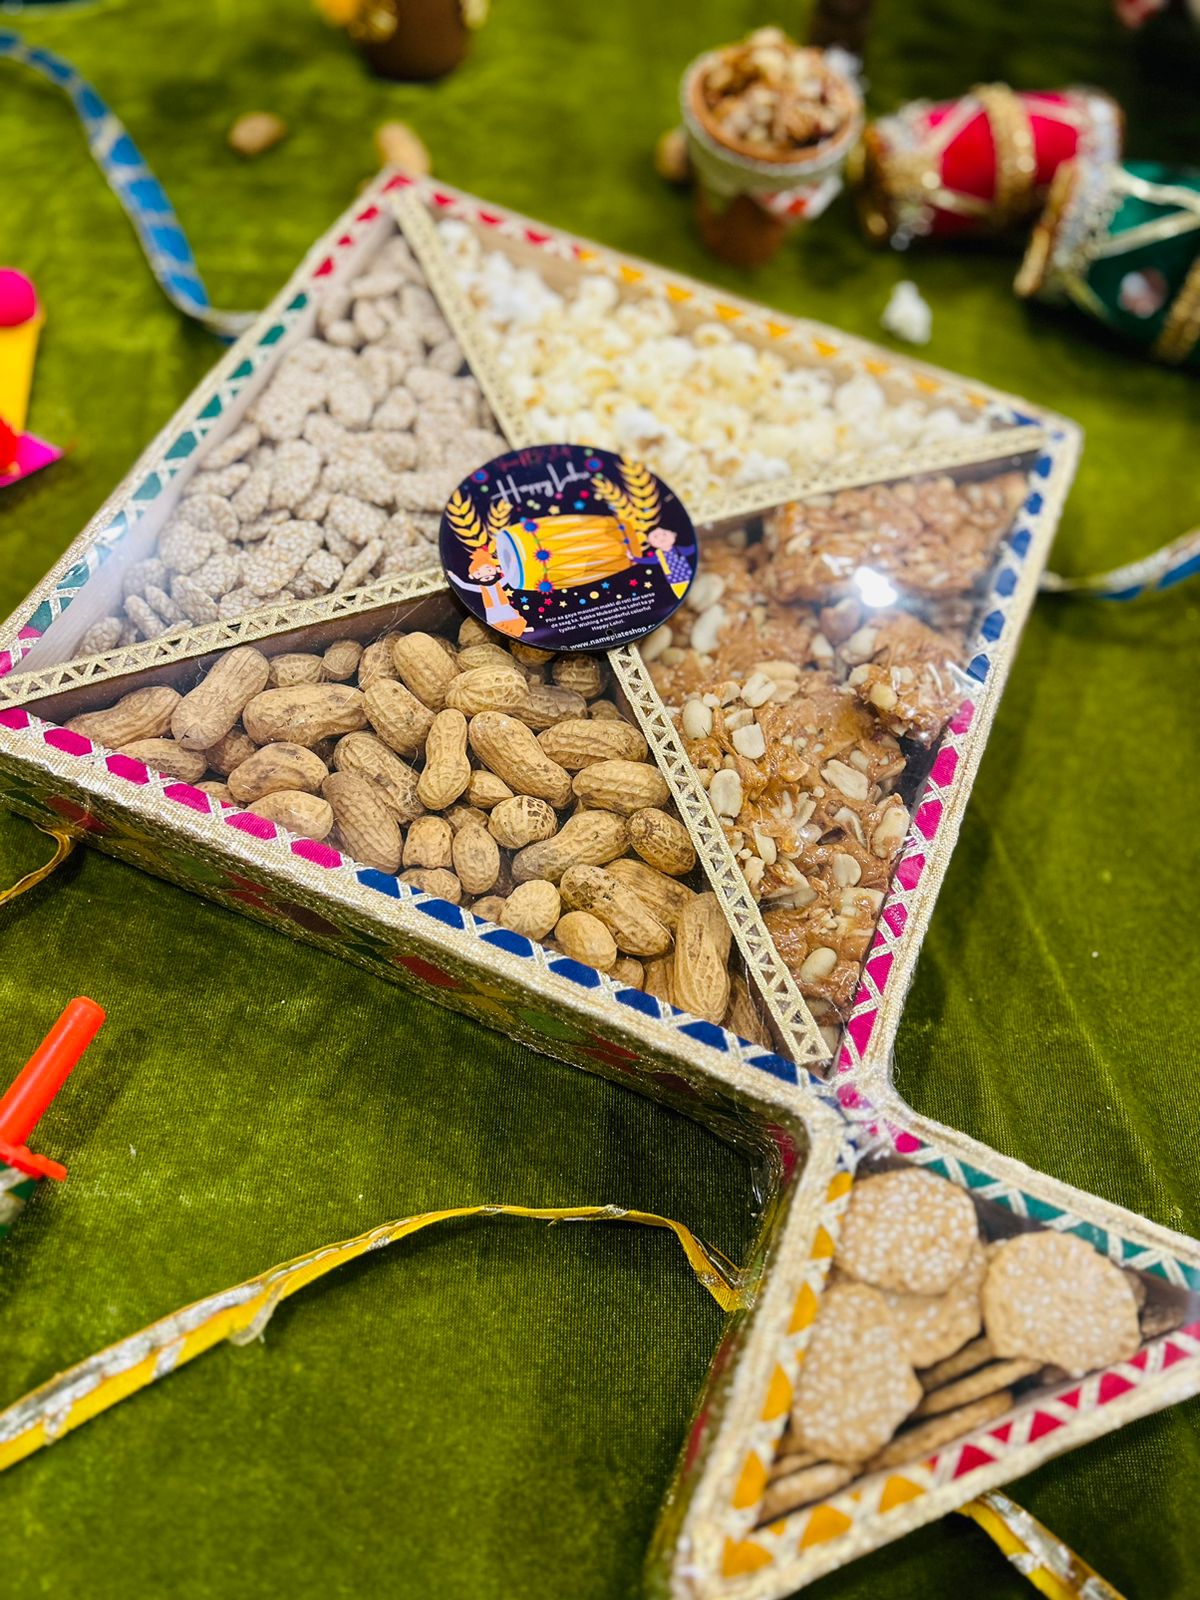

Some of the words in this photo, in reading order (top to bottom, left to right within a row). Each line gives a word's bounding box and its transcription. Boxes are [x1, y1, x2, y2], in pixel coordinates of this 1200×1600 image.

[578, 620, 600, 629] Wishing
[603, 611, 630, 621] wonderful
[630, 606, 651, 615] colorful
